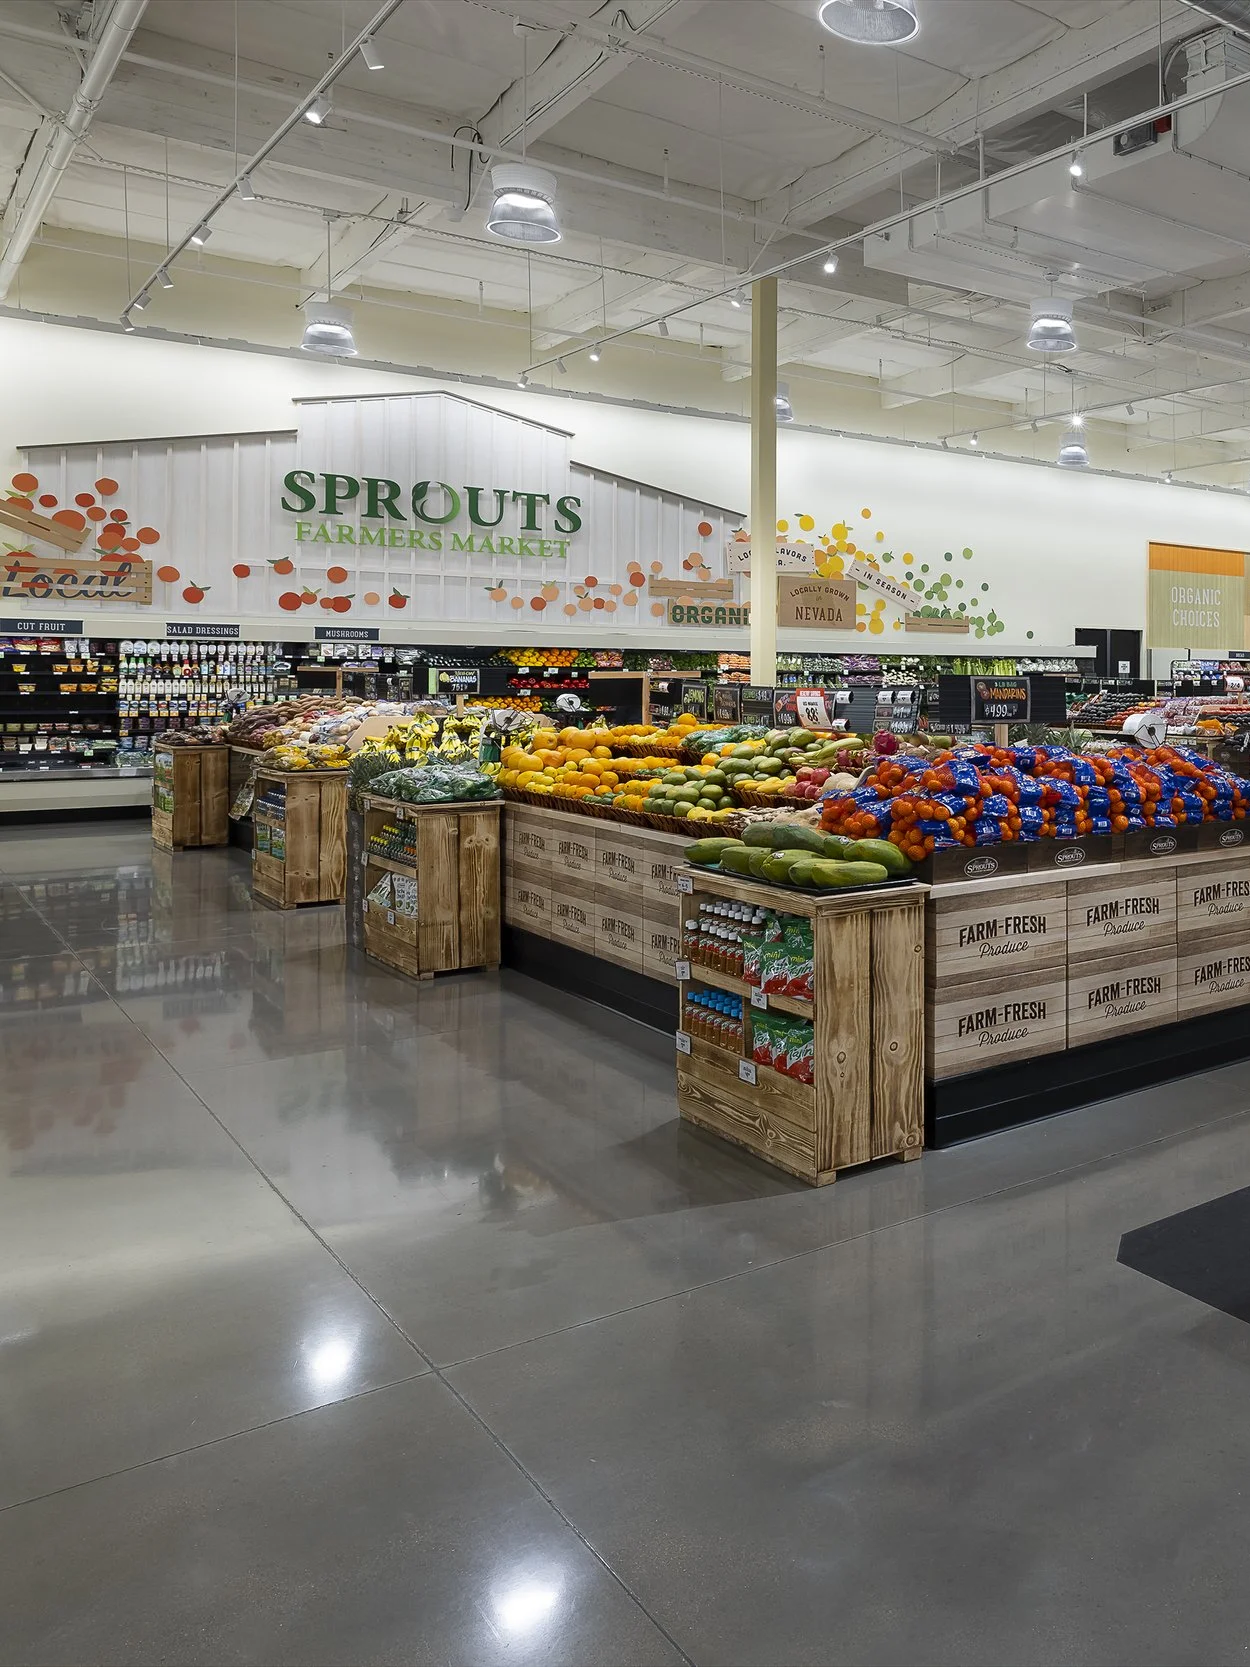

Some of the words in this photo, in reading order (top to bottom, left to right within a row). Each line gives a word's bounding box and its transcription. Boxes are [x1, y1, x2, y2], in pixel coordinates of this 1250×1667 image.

[280, 470, 582, 533] SPROUTS
[294, 521, 443, 550] FARMERS
[450, 532, 571, 558] MARKET
[2, 559, 135, 599] Local
[863, 571, 873, 580] IN
[875, 578, 908, 600] SEASON
[789, 586, 822, 597] LOCALLY
[824, 587, 850, 601] GROWN
[1171, 586, 1221, 606] ORGANIC
[671, 604, 750, 625] ORGANI
[795, 606, 843, 622] NEVADA
[1172, 608, 1220, 628] CHOICES
[17, 622, 36, 631] CUT
[39, 622, 66, 631] FRUIT
[166, 626, 193, 635] SALAD
[195, 626, 239, 636] DRESSINGS
[325, 629, 369, 639] MUSHROOMS
[989, 687, 1027, 700] MANDARINS
[518, 832, 546, 850] FARM-FRESH
[1152, 840, 1175, 851] SPROUTS
[1220, 834, 1242, 844] SPROUTS
[558, 841, 589, 861] FARM-FRESH
[1058, 852, 1083, 863] SPROUTS
[563, 856, 582, 870] Produce
[602, 851, 635, 874] FARM-FRESH
[967, 862, 995, 874] SPROUTS
[608, 867, 628, 883] Produce
[517, 889, 545, 911] FARM-FRESH
[1207, 900, 1245, 917] Produce
[556, 904, 587, 926] FARM-FRESH
[1086, 898, 1160, 927] FARM-FRESH
[562, 919, 581, 934] Produce
[601, 918, 635, 942] FARM-FRESH
[959, 916, 1046, 948] FARM-FRESH
[1103, 919, 1145, 937] Produce
[607, 933, 628, 950] Produce
[978, 939, 1029, 958] Produce
[1088, 977, 1161, 1010] FARM-FRESH
[1209, 977, 1246, 995] Produce
[1104, 999, 1147, 1019] Produce
[958, 1002, 1046, 1038] FARM-FRESH
[978, 1026, 1029, 1048] Produce
